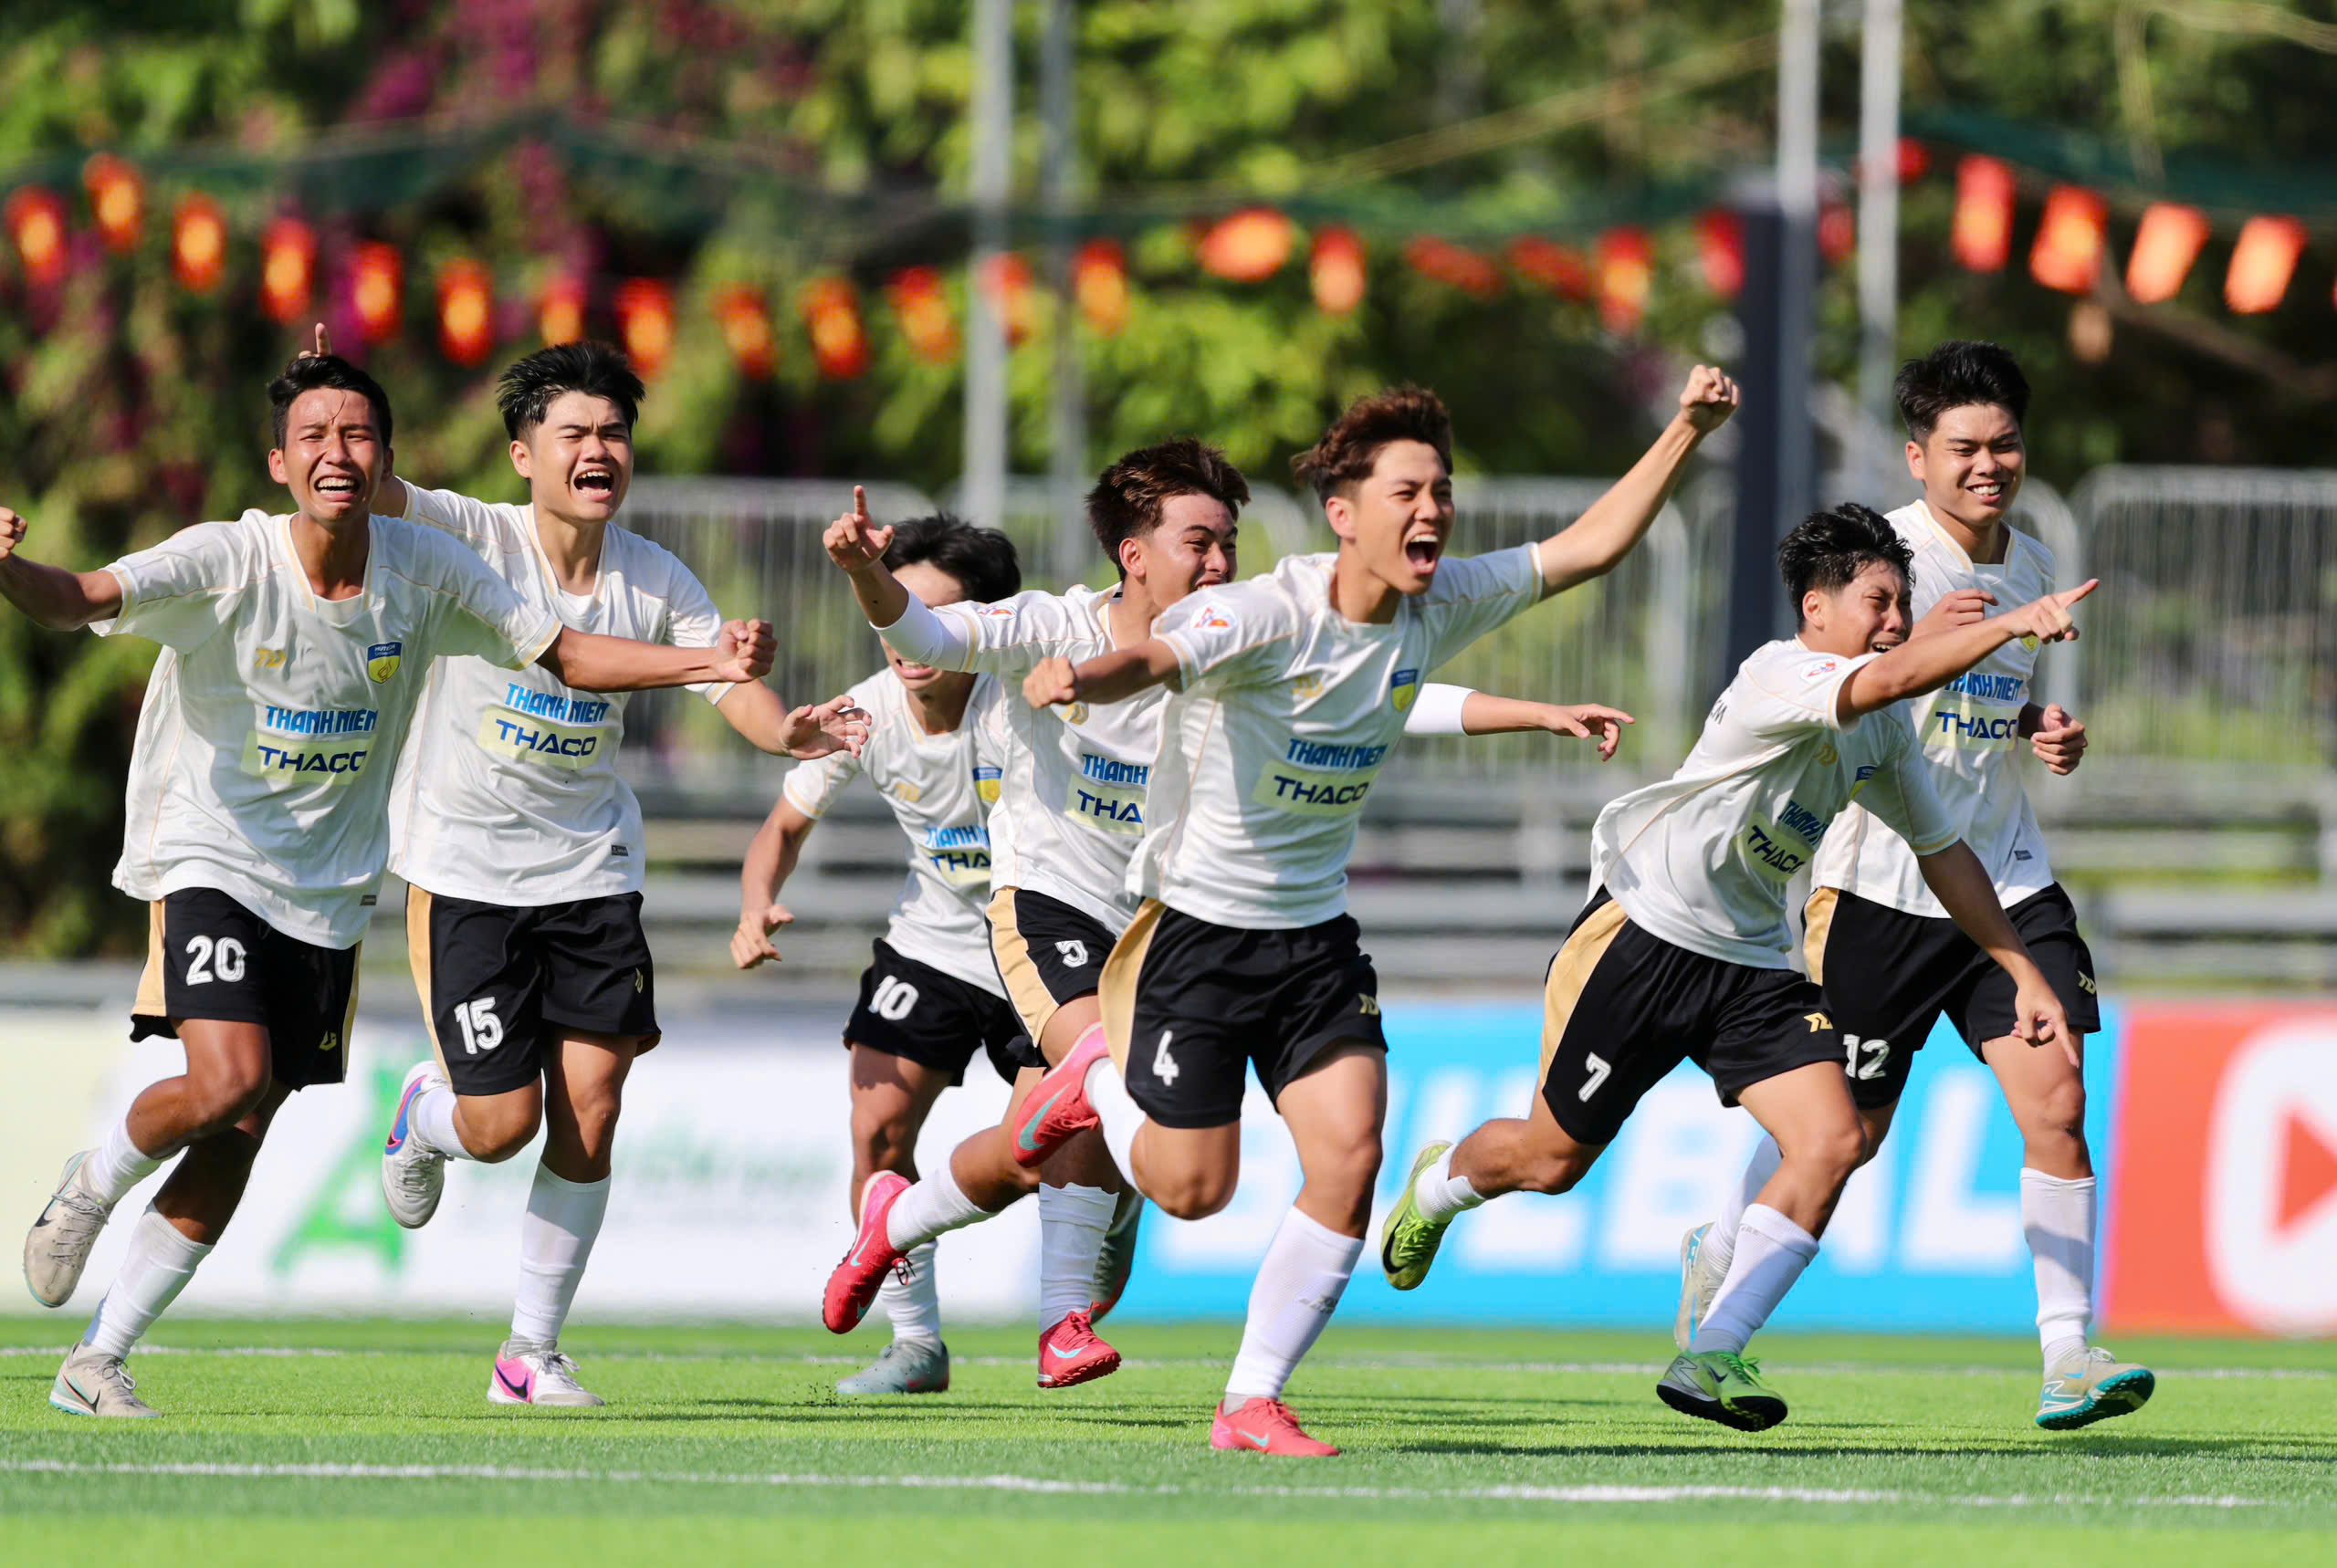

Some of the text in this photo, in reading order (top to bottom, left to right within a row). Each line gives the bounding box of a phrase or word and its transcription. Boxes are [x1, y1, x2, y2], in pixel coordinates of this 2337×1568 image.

[266, 705, 334, 734] THANH
[504, 682, 570, 721] THANH
[496, 718, 597, 758] THACO
[1287, 737, 1349, 768] THANH
[1081, 754, 1148, 786] THANH
[1273, 775, 1369, 805] THACO
[185, 935, 246, 986] 20
[868, 975, 919, 1020] 10
[454, 997, 503, 1054] 15
[1152, 1030, 1179, 1086] 4
[1577, 1051, 1611, 1103] 7
[1843, 1033, 1890, 1081] 12
